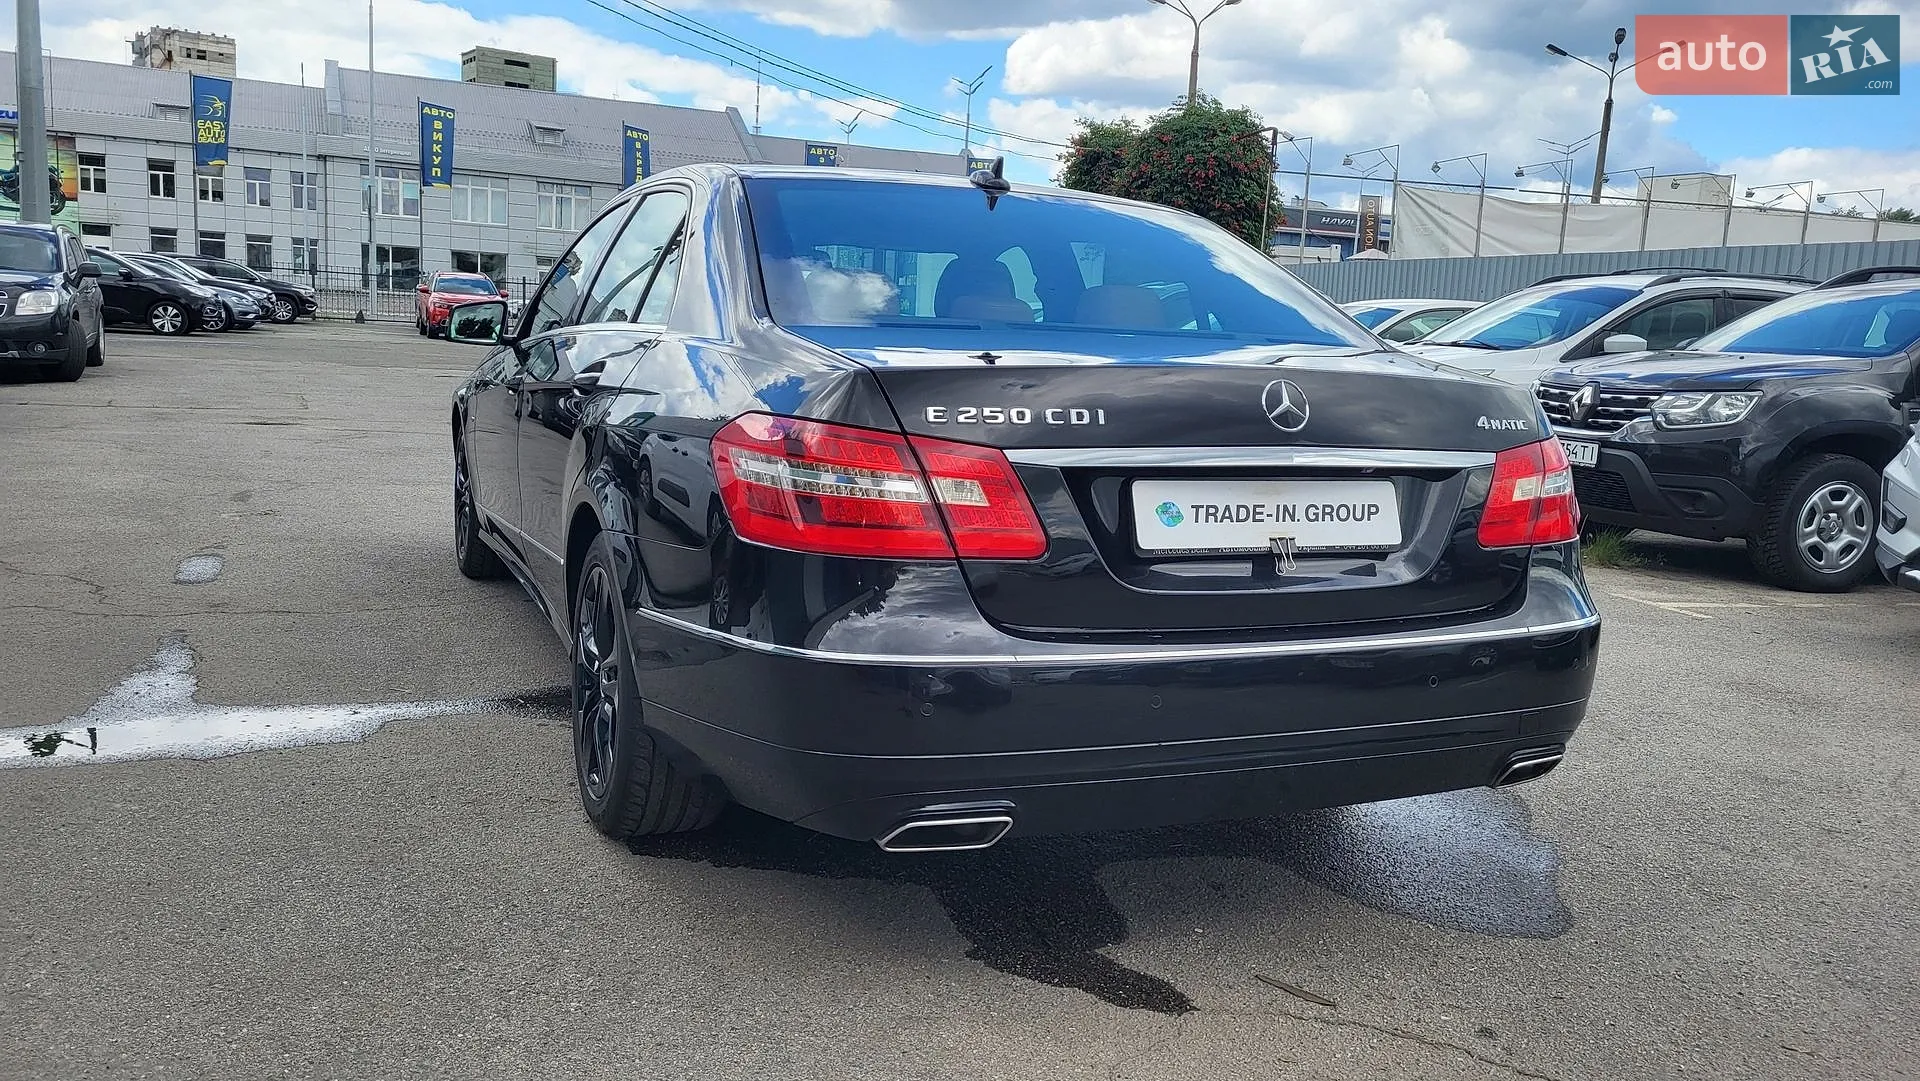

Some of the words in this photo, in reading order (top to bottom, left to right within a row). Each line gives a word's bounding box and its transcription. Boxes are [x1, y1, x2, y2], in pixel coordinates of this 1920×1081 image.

[422, 106, 455, 119] АВТО
[197, 119, 227, 130] EASY
[198, 128, 226, 138] AUTO
[626, 129, 649, 141] АВТО
[431, 120, 443, 177] ВИКУП
[809, 147, 835, 156] АВТО
[635, 151, 643, 183] КРЕД
[1320, 216, 1356, 227] HAVAL
[926, 406, 948, 424] E
[956, 406, 1033, 425] 250
[1044, 407, 1106, 426] CDI
[1476, 415, 1529, 431] 4MATIC
